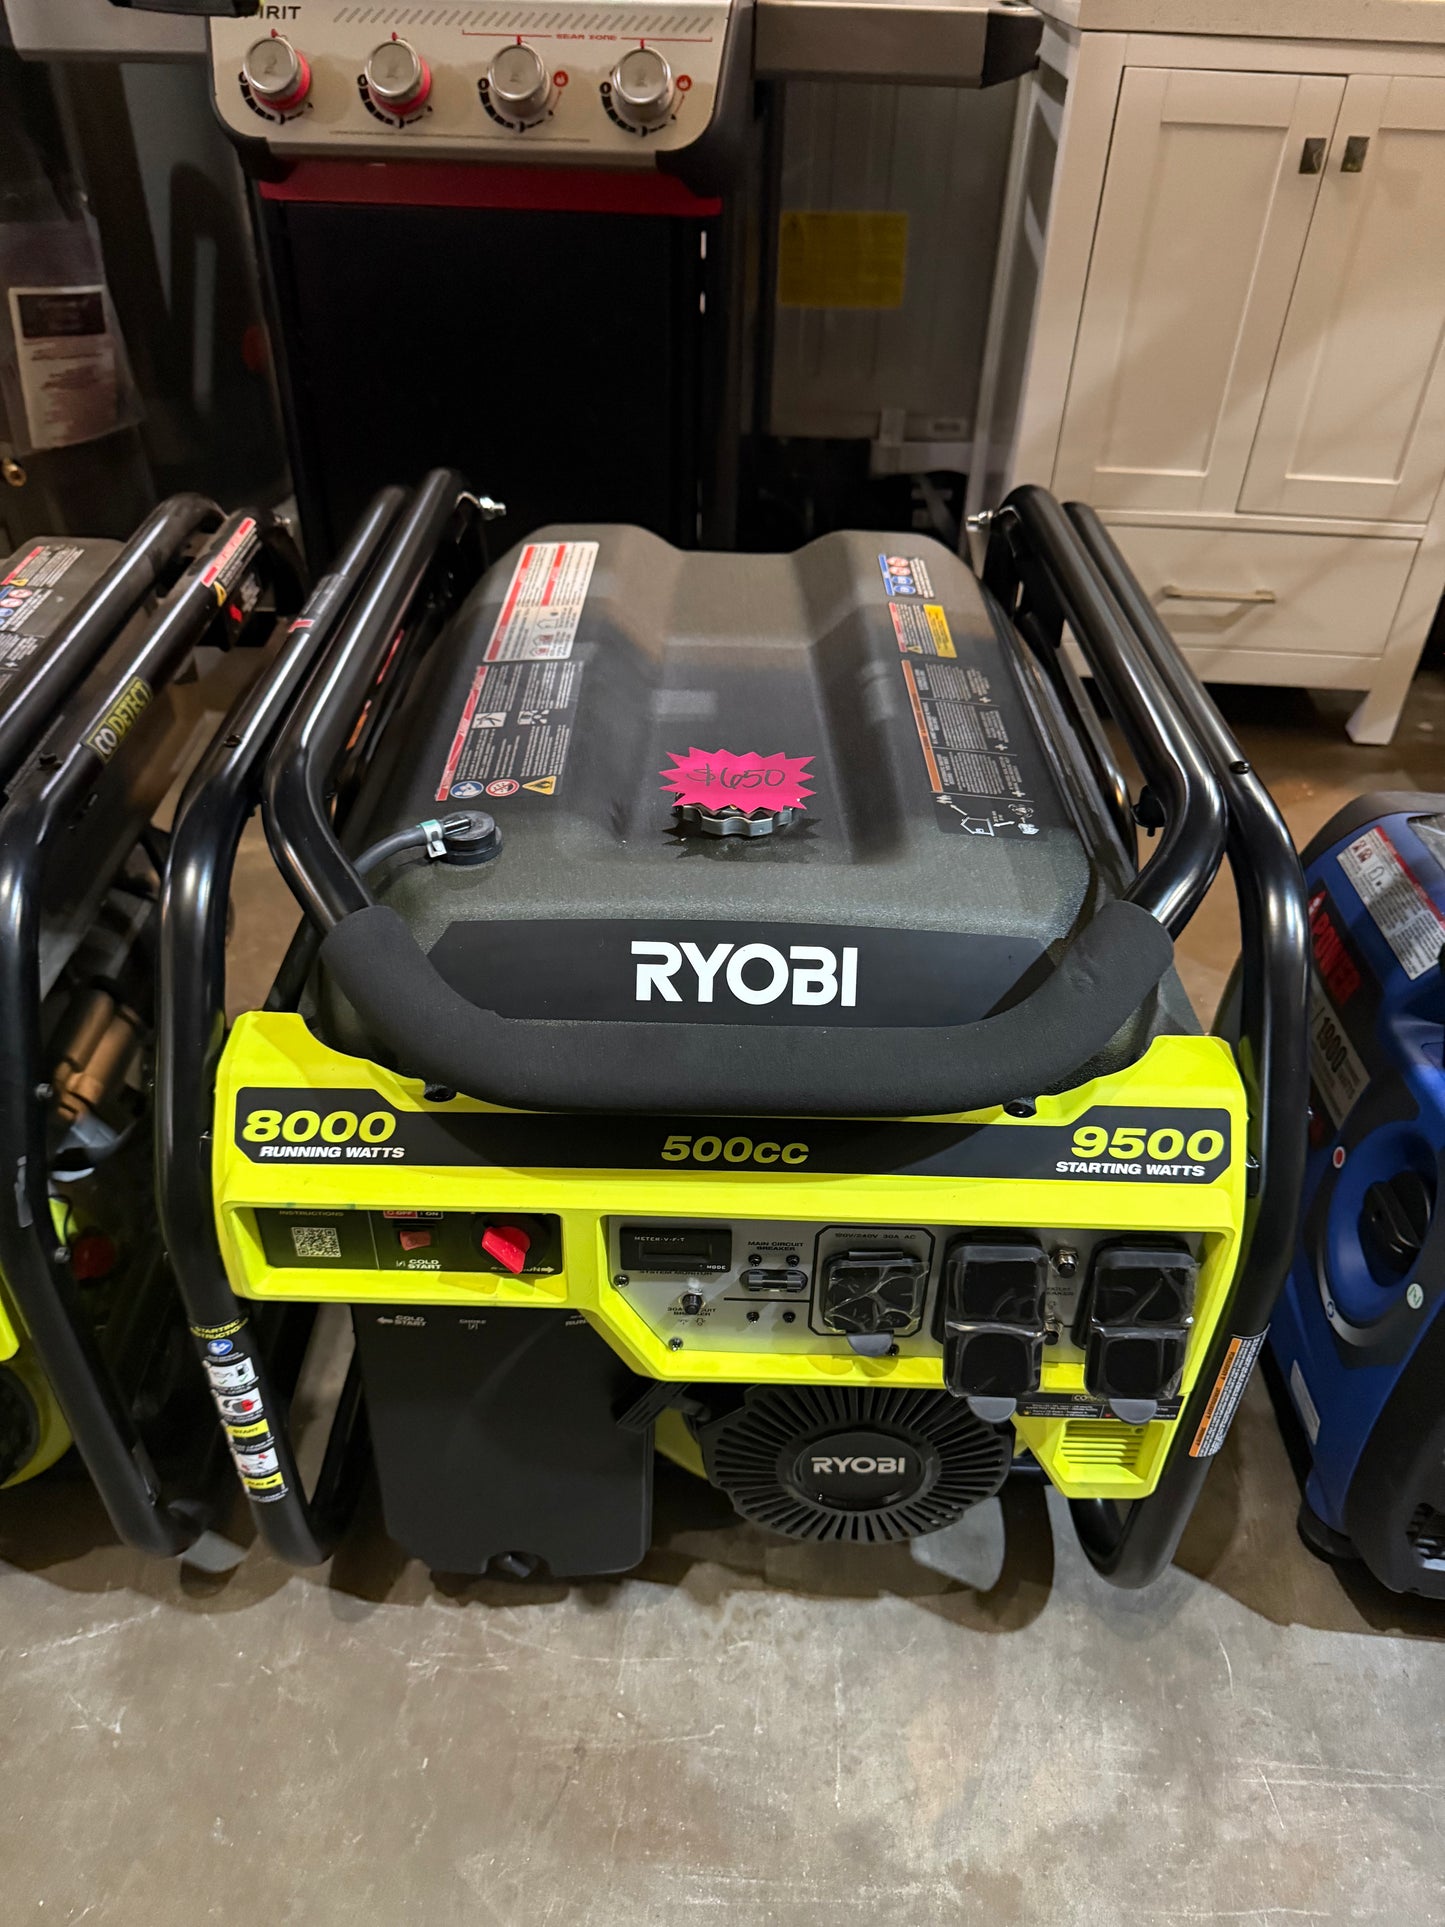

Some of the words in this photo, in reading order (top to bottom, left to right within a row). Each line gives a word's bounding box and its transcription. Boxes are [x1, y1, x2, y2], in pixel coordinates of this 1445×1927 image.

[259, 5, 301, 19] IRIT
[95, 728, 117, 755] CO
[108, 681, 151, 736] DETECT
[686, 763, 785, 789] $650
[631, 941, 858, 1007] RYOBI
[243, 1110, 396, 1143] 8000
[259, 1146, 341, 1158] RUNNING
[345, 1147, 405, 1158] WATTS
[661, 1136, 809, 1164] 500cc
[1071, 1126, 1224, 1161] 9500
[1056, 1161, 1142, 1175] STARTING
[1146, 1164, 1205, 1177] WATTS
[811, 1456, 905, 1473] RYOBI
